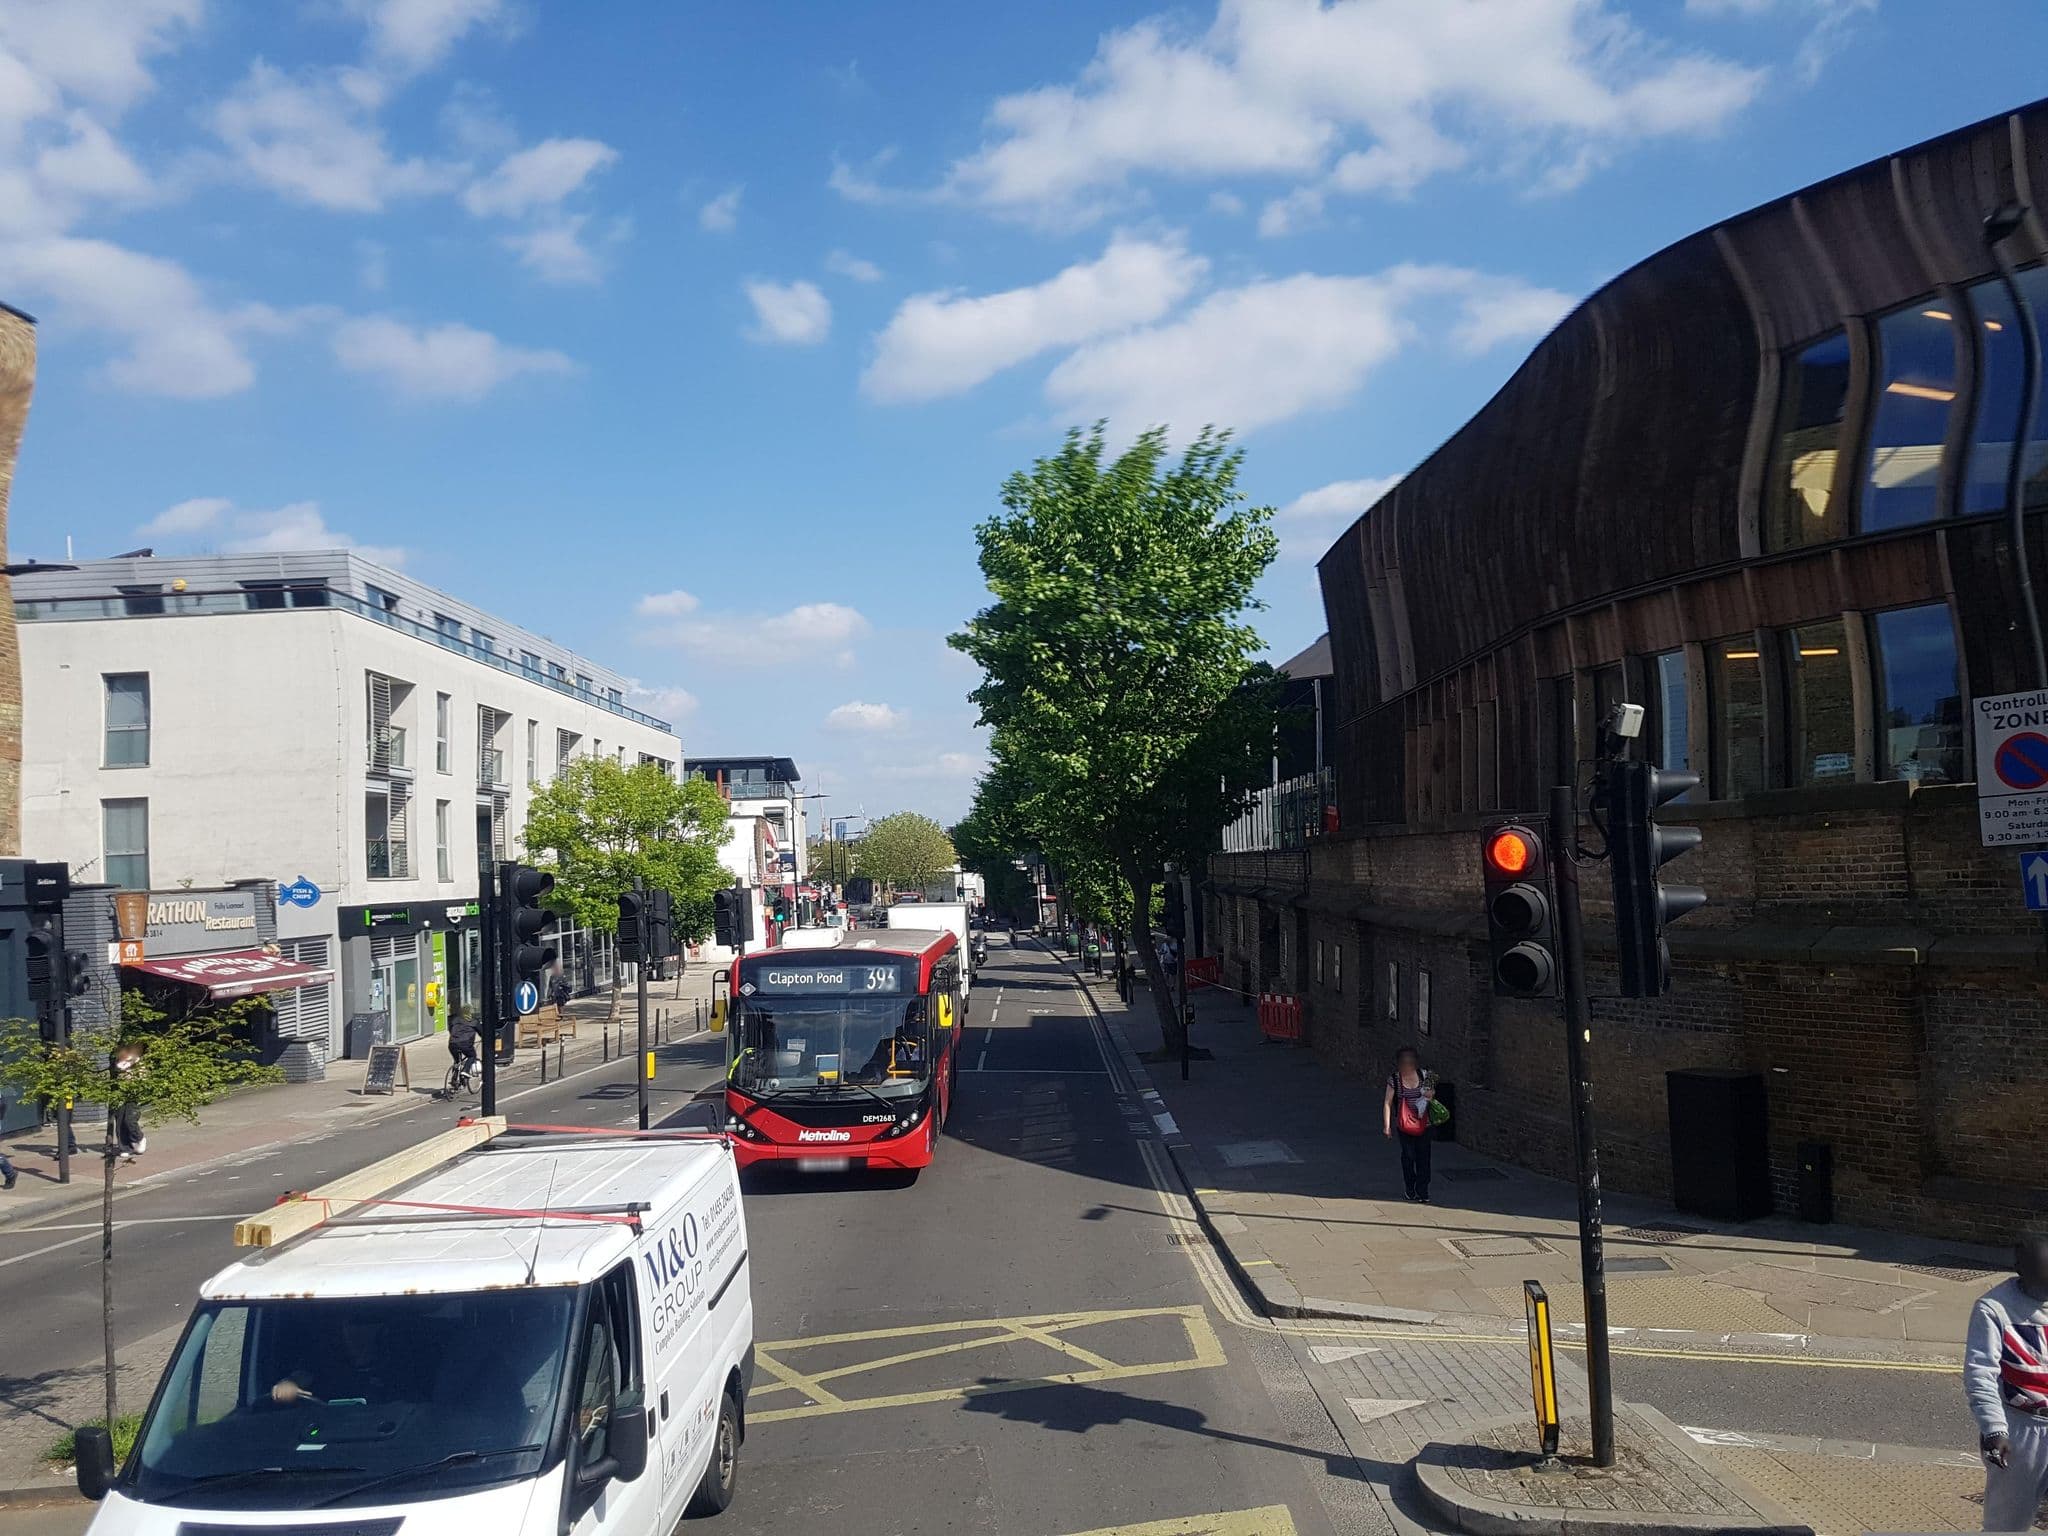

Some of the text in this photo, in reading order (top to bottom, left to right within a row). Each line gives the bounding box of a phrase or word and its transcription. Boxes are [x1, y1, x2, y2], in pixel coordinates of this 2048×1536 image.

[147, 900, 206, 924] RATHON
[205, 915, 256, 930] Restaurant
[768, 972, 813, 987] Clapton
[816, 972, 843, 984] Pond
[862, 1114, 896, 1123] DEM2683
[799, 1130, 851, 1141] Metroline
[643, 1212, 698, 1303] M&O
[653, 1260, 703, 1334] GROUP
